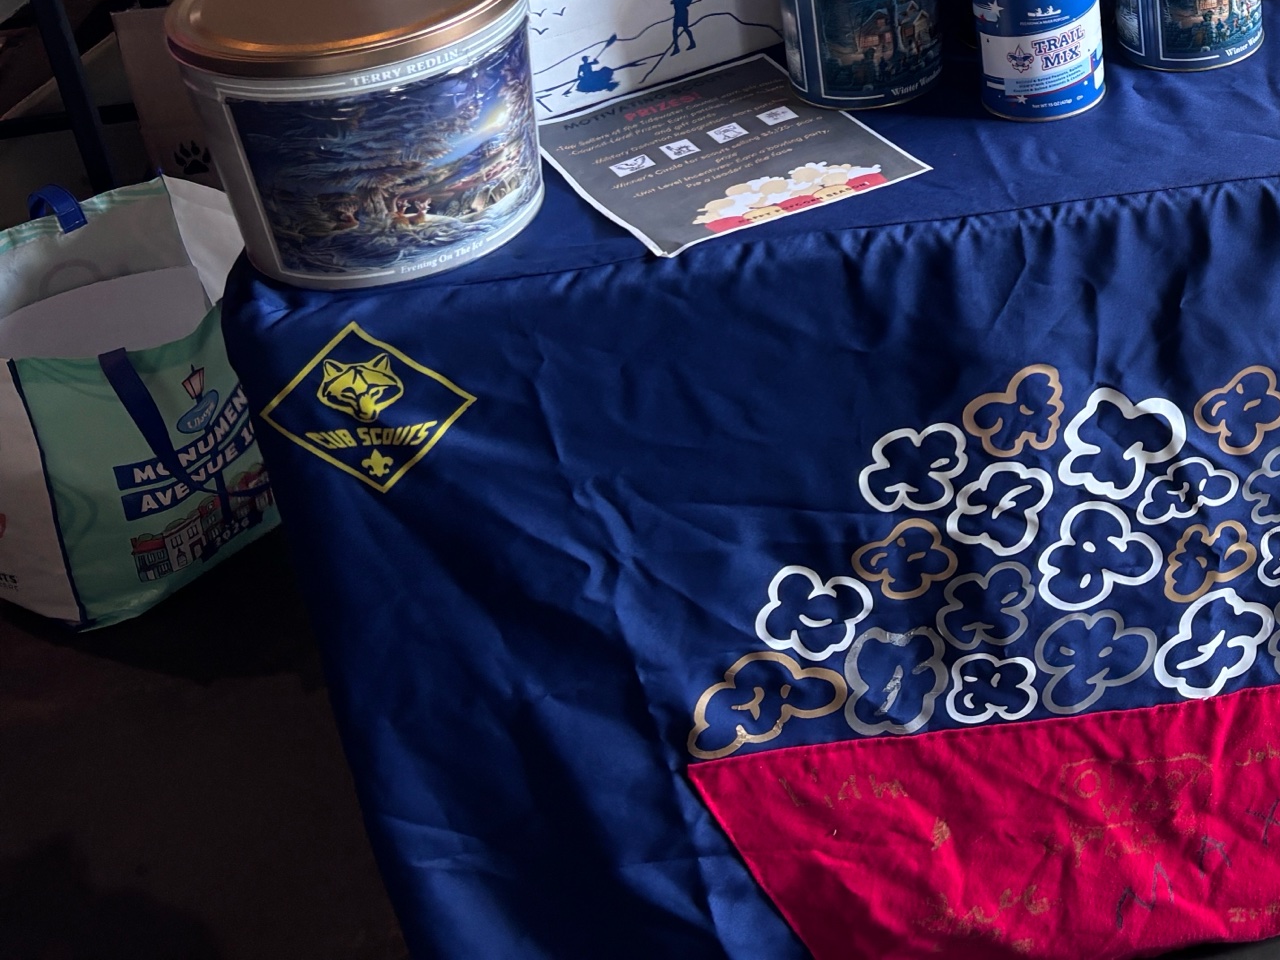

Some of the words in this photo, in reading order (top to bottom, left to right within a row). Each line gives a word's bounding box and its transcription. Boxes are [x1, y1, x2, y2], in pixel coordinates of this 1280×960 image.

[1032, 25, 1084, 55] TRAIL
[1225, 44, 1248, 57] Winter
[350, 67, 402, 86] TERRY
[406, 48, 459, 74] REDLIN
[1043, 44, 1080, 69] MIX
[891, 81, 919, 97] Winter
[564, 93, 668, 131] MOTIVATING
[624, 92, 700, 122] PRIZES!
[639, 108, 683, 125] Tidewater
[654, 127, 673, 136] and
[673, 120, 690, 133] gift
[691, 113, 717, 124] cards
[630, 134, 673, 153] Donation
[655, 162, 684, 176] Circle
[685, 156, 699, 165] for
[700, 145, 730, 160] scouts
[731, 136, 760, 151] selling
[796, 118, 817, 130] pick
[714, 151, 738, 164] prize
[657, 178, 684, 192] Level
[766, 136, 804, 153] bowling
[804, 128, 830, 142] party,
[685, 180, 703, 190] Pie
[712, 166, 743, 181] leader
[755, 154, 771, 164] the
[771, 147, 793, 157] face
[738, 211, 772, 225] HAPPY
[774, 196, 824, 214] POPCORN
[826, 181, 870, 201] SEASON!
[401, 257, 438, 274] Evening
[438, 253, 453, 263] On
[454, 245, 471, 258] The
[472, 240, 484, 251] Ice
[134, 387, 249, 484] MONUMEN
[305, 429, 357, 449] CUB
[357, 420, 438, 446] SCOUTS
